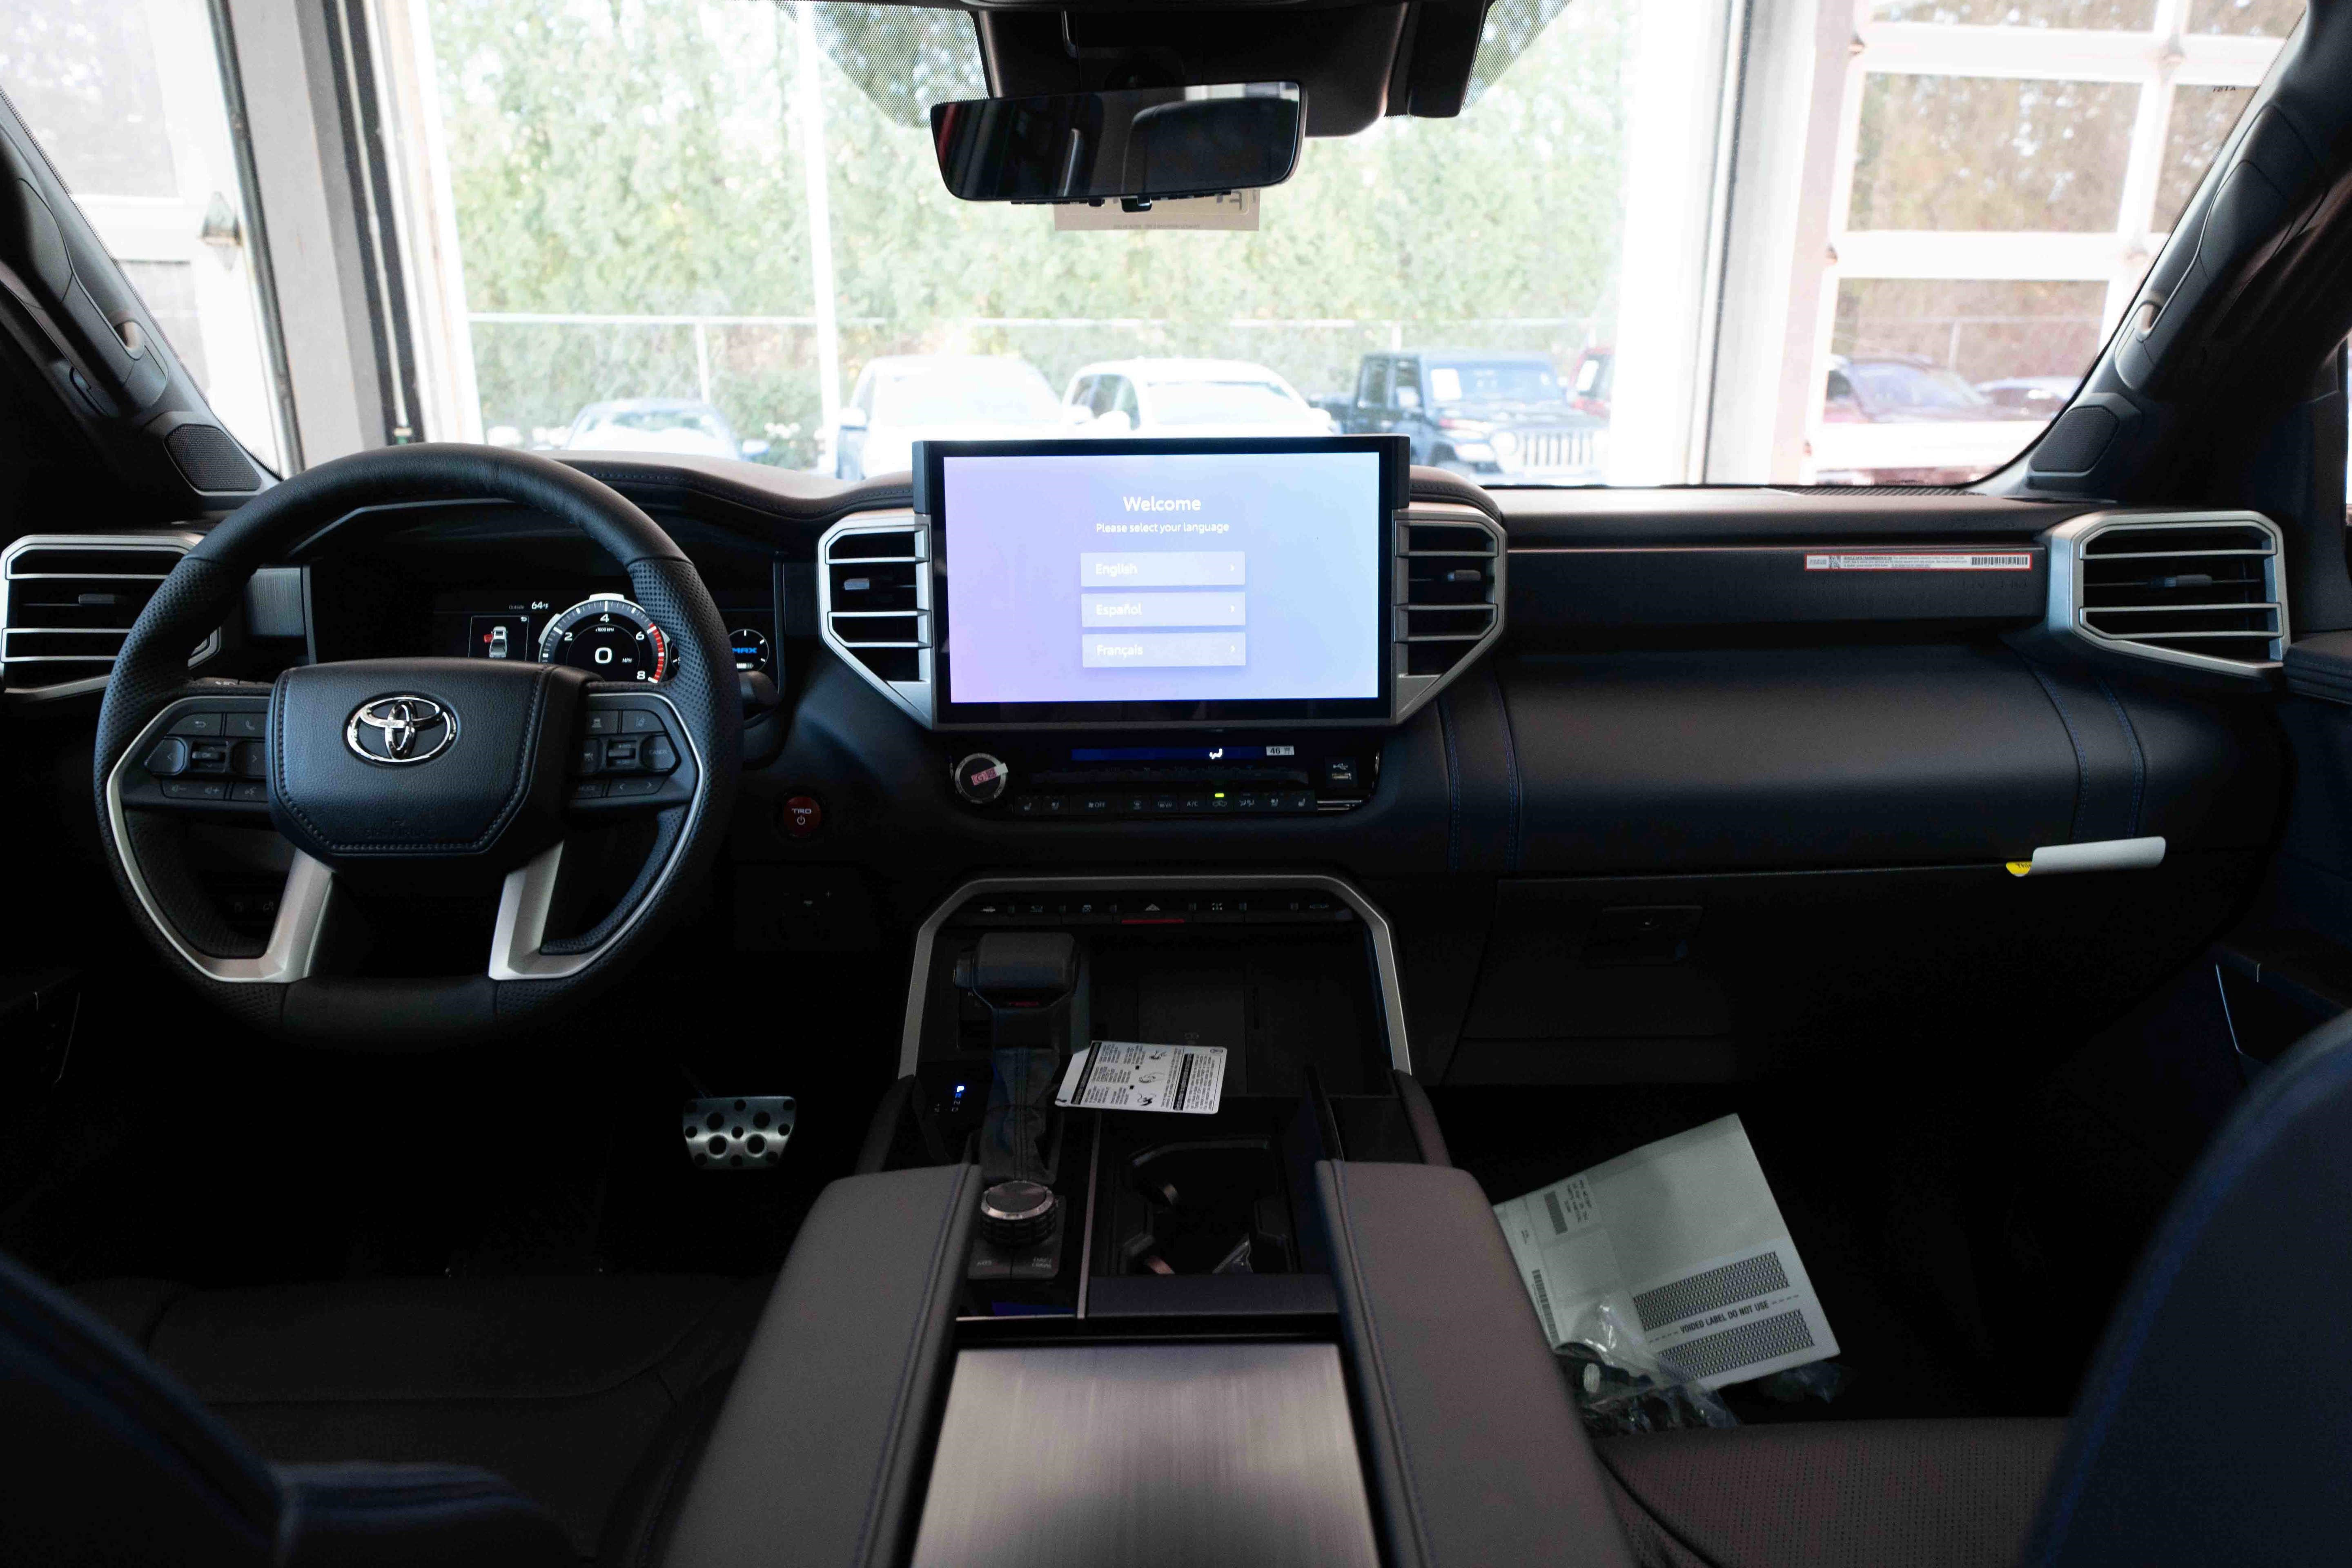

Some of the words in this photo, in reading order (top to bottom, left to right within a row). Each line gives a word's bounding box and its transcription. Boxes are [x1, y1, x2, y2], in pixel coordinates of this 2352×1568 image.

[1123, 496, 1201, 511] Welcome
[1096, 523, 1127, 533] Please
[1129, 523, 1157, 532] select
[1160, 523, 1181, 534] your
[1183, 522, 1229, 534] language
[1096, 563, 1138, 577] English
[1096, 602, 1142, 617] Español
[600, 614, 610, 623] 4
[564, 632, 572, 641] 2
[635, 631, 645, 640] 6
[595, 647, 612, 664] 0
[1097, 644, 1143, 659] Français
[637, 670, 646, 680] 8
[1680, 1319, 1704, 1333] VOIDED
[1705, 1314, 1726, 1325] LABEL
[1728, 1310, 1738, 1319] DO
[1739, 1305, 1753, 1316] NOT
[1754, 1300, 1769, 1310] USE
